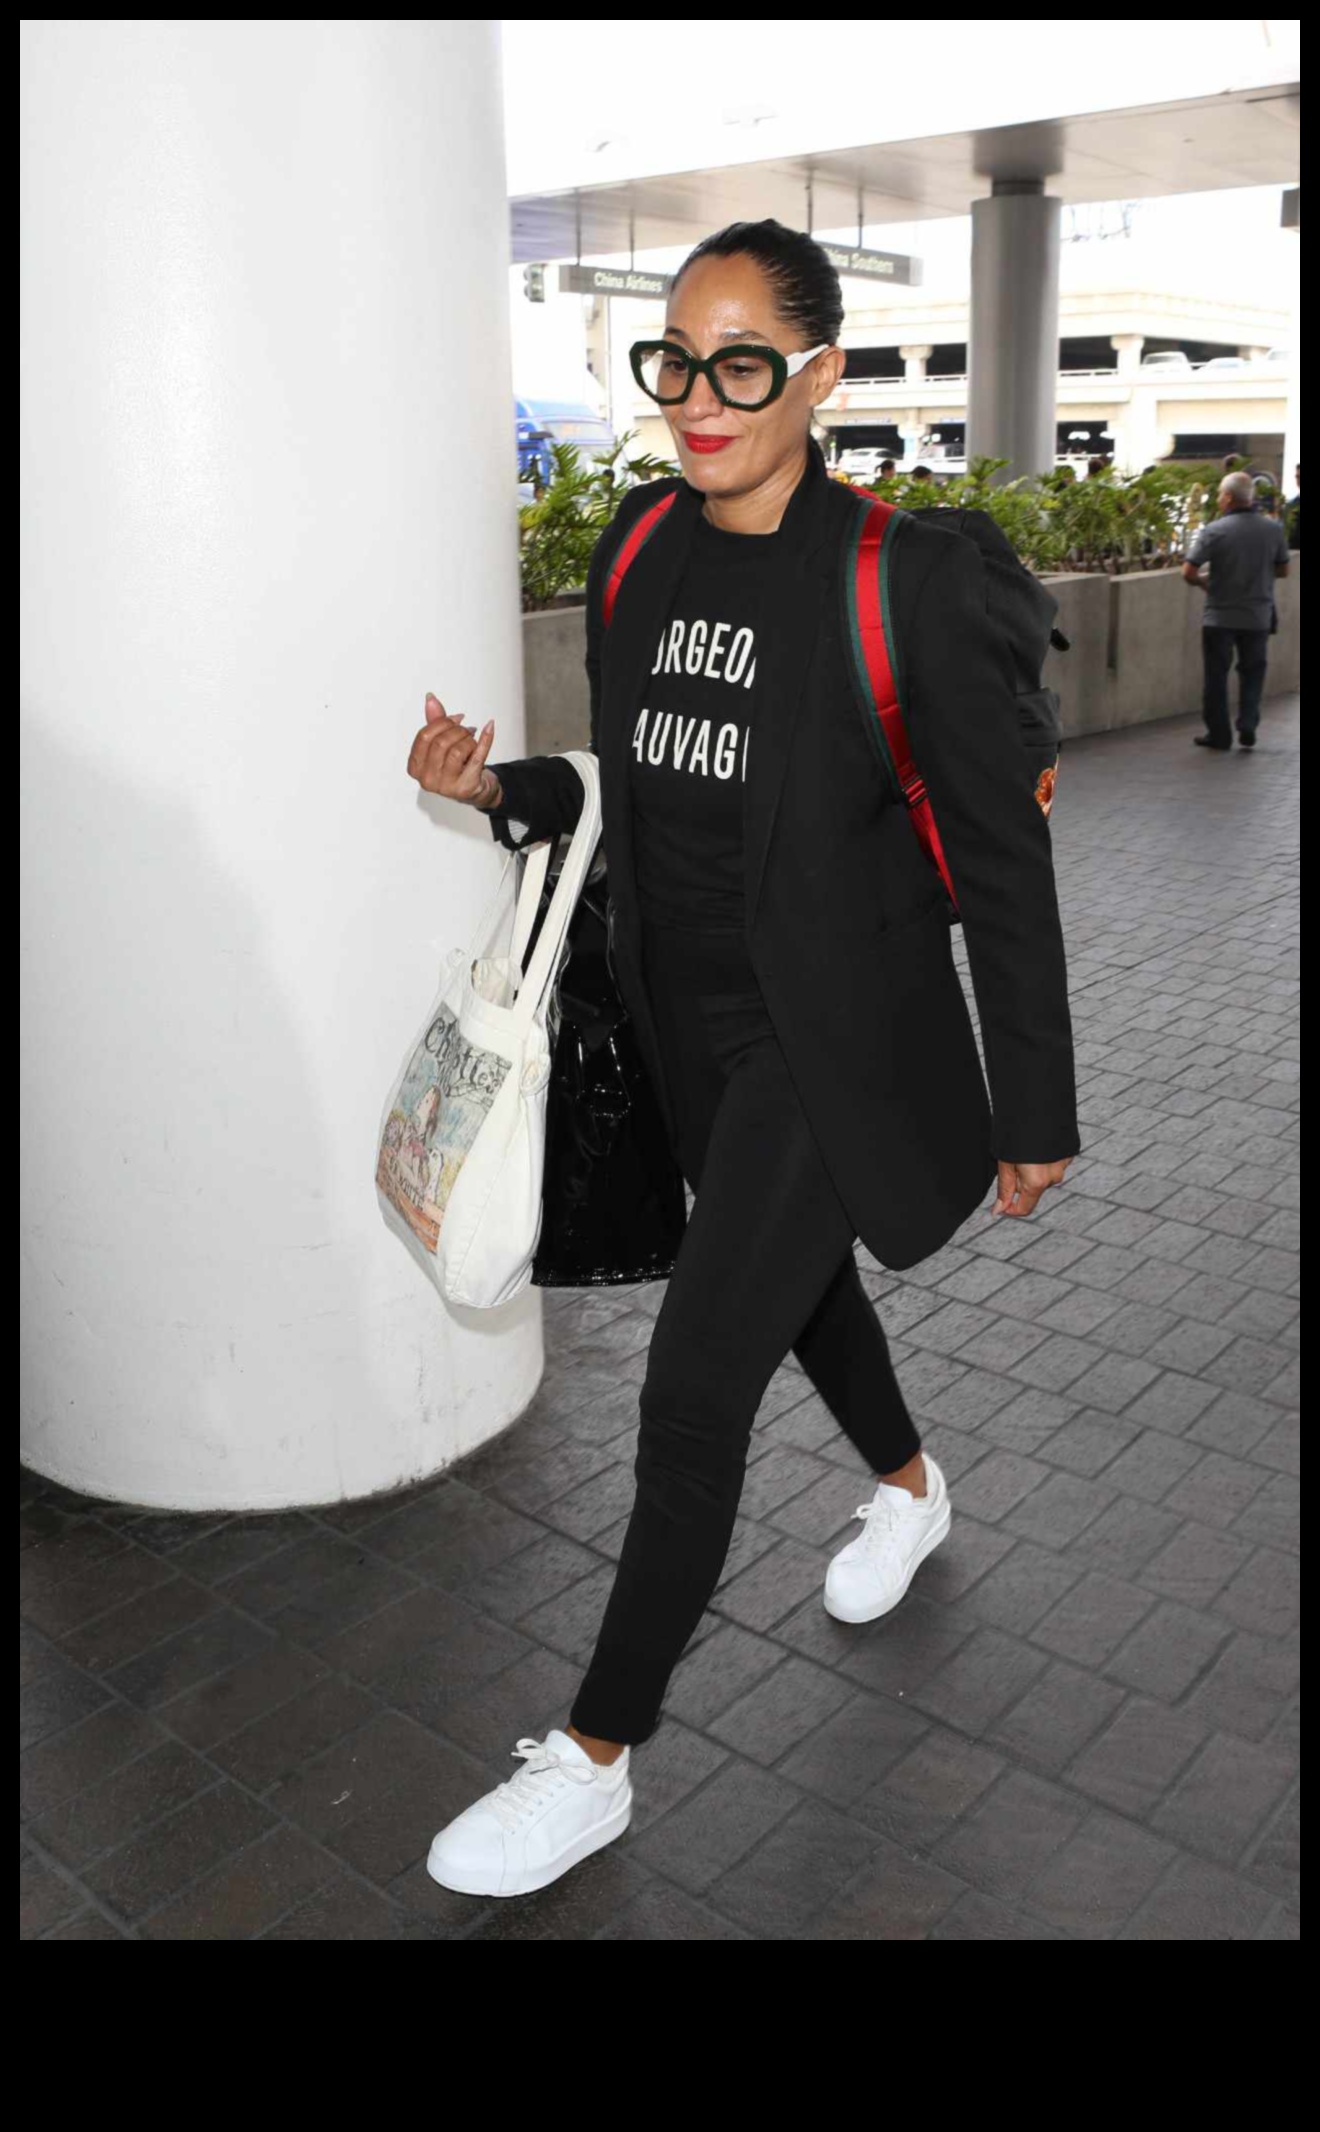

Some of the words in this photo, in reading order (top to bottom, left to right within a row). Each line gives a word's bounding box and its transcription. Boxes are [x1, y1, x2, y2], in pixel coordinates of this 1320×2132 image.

[823, 248, 849, 268] hina
[851, 252, 895, 275] Southern
[594, 271, 625, 289] China
[625, 274, 663, 294] Airlines
[632, 708, 750, 782] AUVAG
